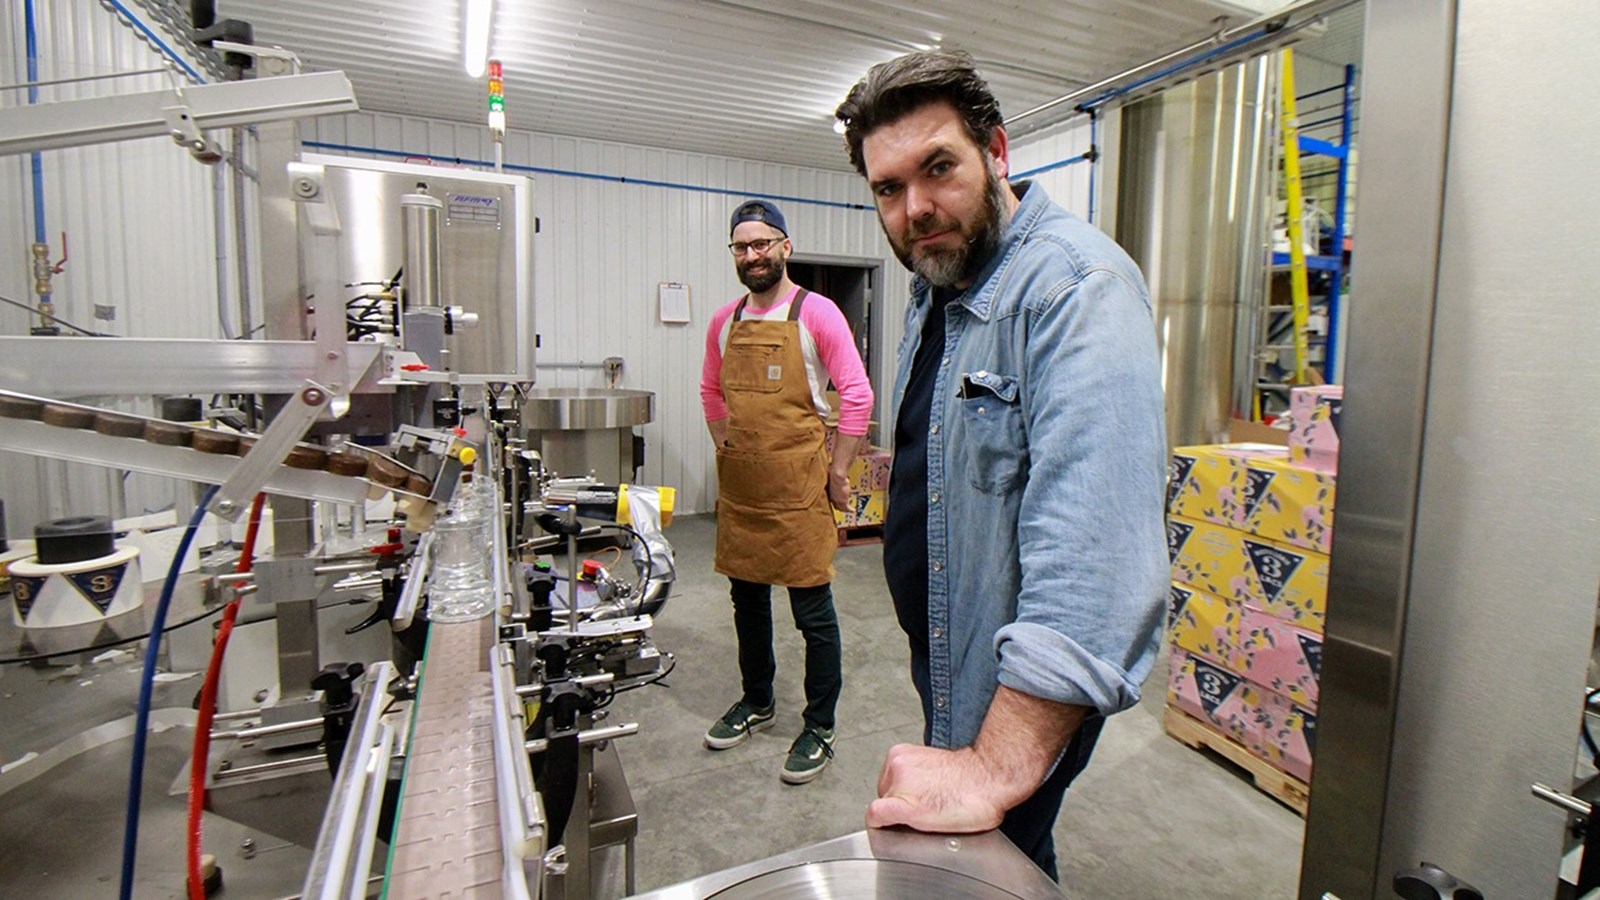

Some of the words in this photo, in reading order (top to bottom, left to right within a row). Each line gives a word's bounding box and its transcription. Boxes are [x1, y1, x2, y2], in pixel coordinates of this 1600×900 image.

[1262, 555, 1282, 578] 3
[90, 575, 114, 593] 3
[1202, 673, 1221, 695] 3
